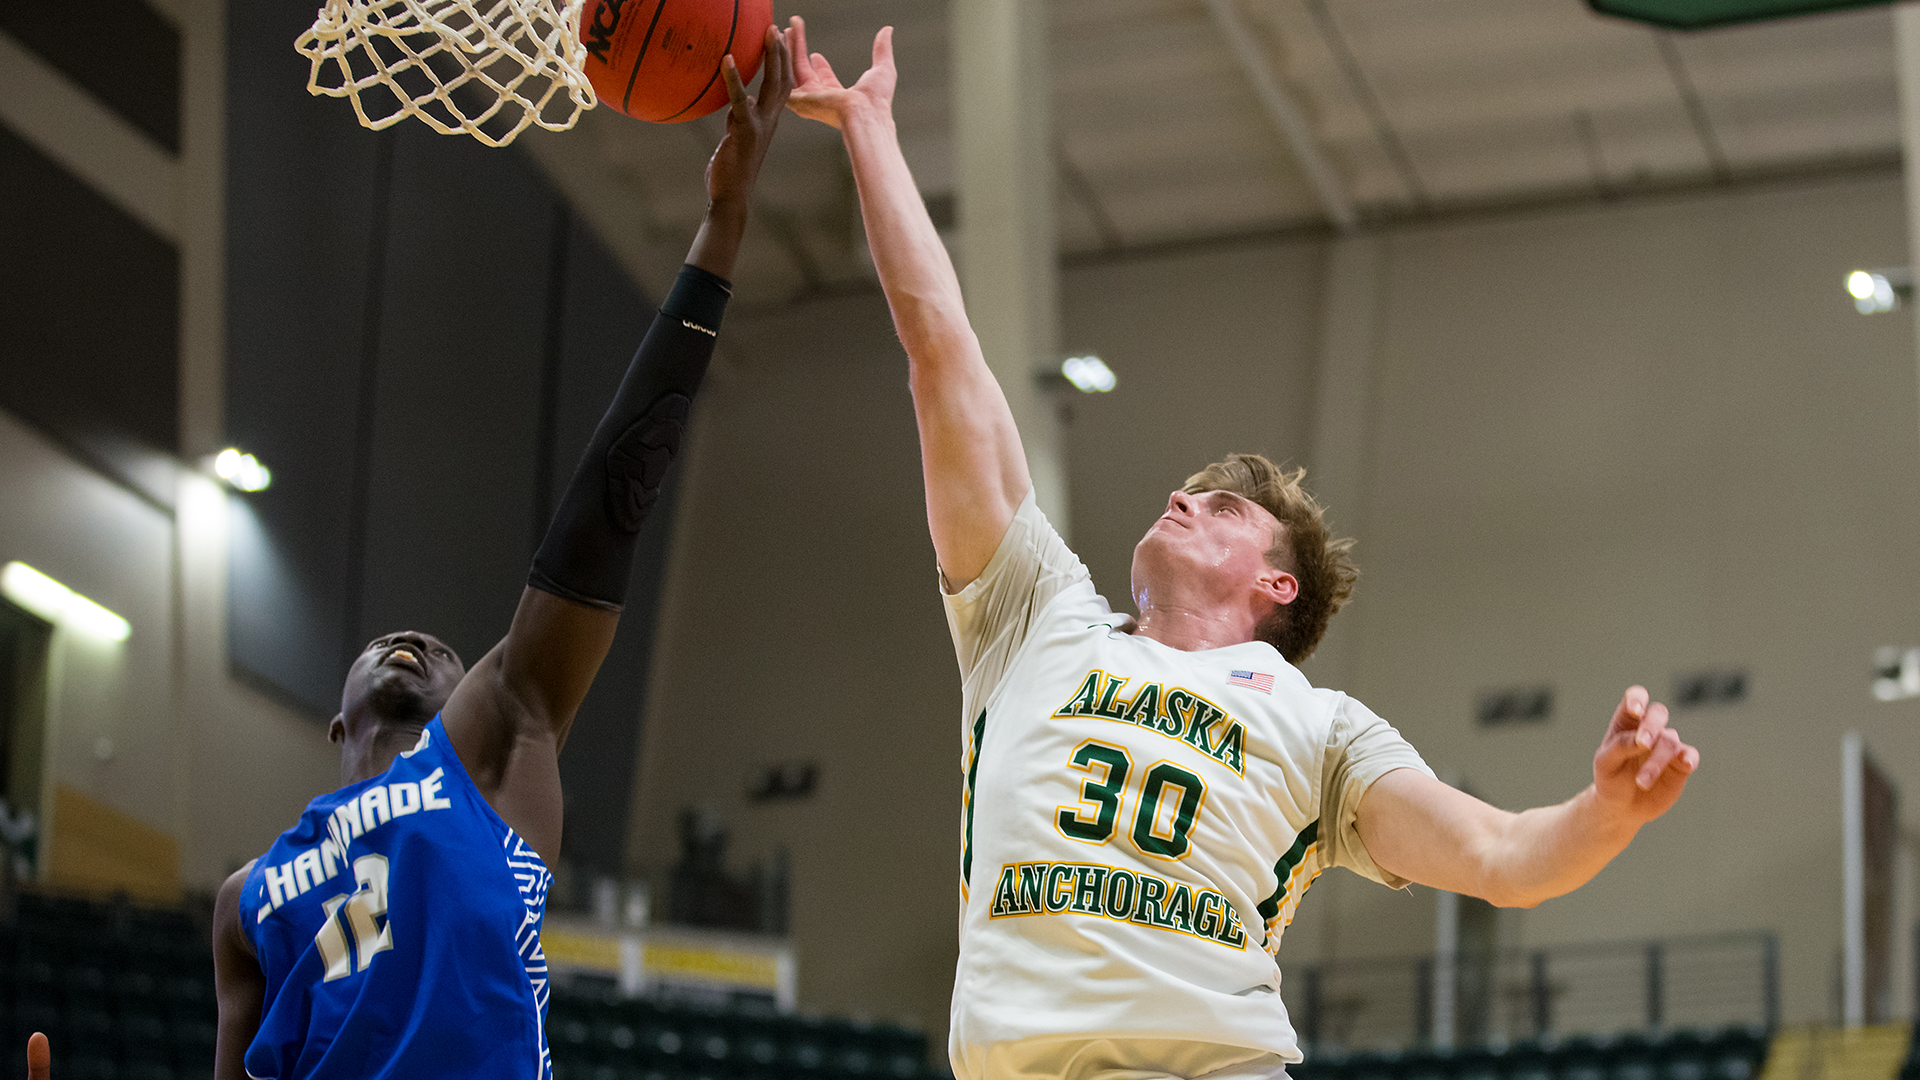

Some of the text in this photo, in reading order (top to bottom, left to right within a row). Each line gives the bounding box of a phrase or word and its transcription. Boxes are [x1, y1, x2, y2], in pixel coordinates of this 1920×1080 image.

[1051, 669, 1247, 780] ALASKA
[1054, 738, 1208, 862] 30
[314, 853, 394, 983] 12
[989, 861, 1247, 951] ANCHORAGE
